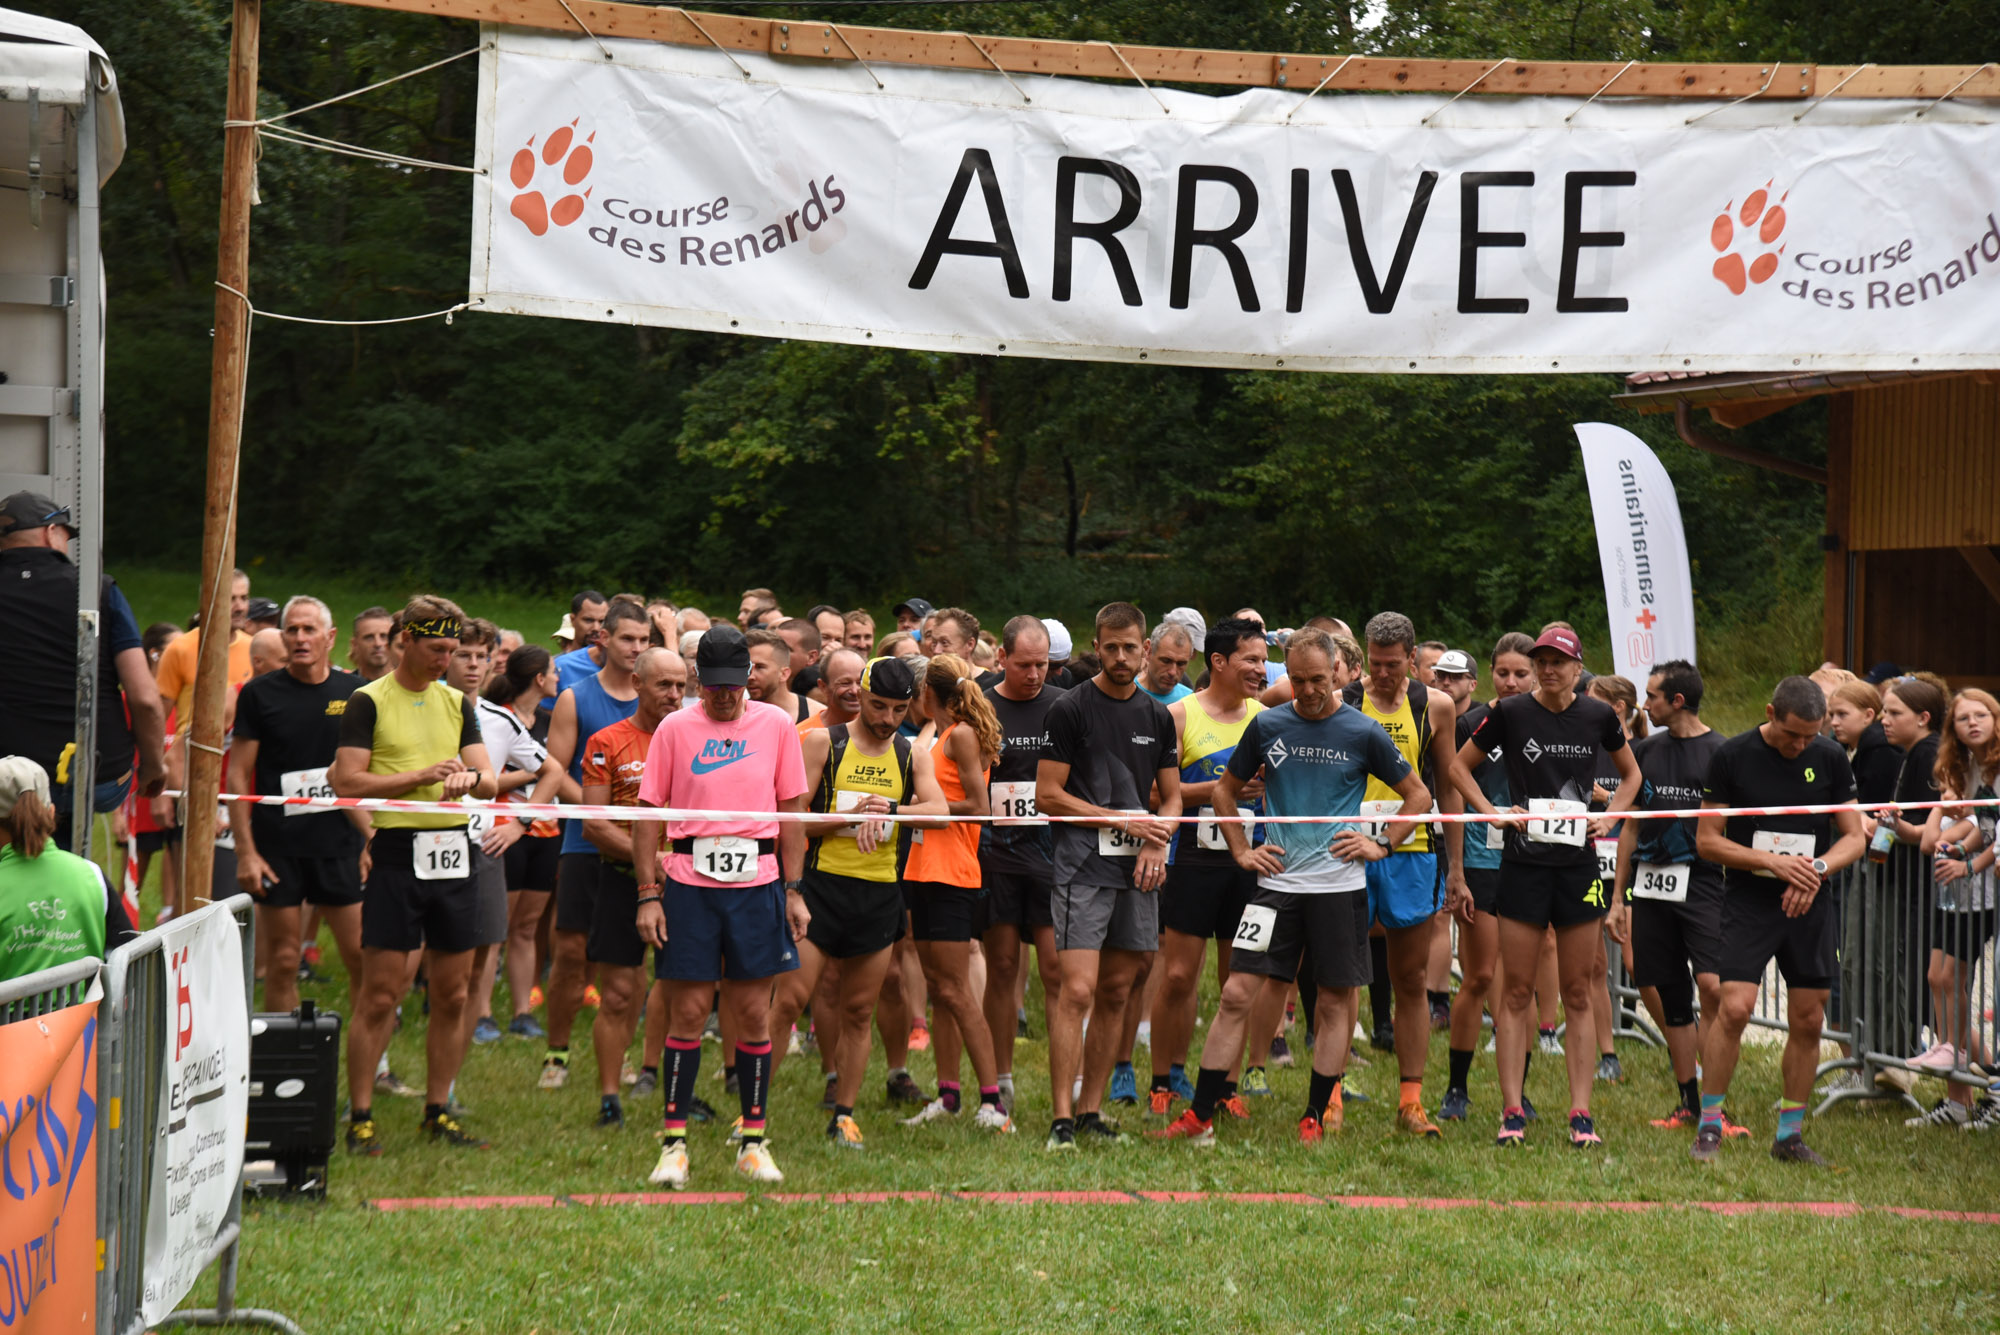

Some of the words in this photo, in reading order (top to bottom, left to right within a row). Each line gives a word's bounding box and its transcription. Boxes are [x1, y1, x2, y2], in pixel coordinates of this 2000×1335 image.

[588, 226, 666, 264] des
[679, 174, 846, 267] Renards
[602, 196, 729, 228] Course
[908, 147, 1637, 315] ARRIVEE
[1794, 238, 1913, 275] Course
[1781, 279, 1855, 310] des
[701, 739, 747, 758] RUN
[1290, 746, 1349, 761] VERTICAL
[1543, 744, 1593, 754] VERTICAL
[855, 765, 887, 777] USY
[1655, 785, 1703, 798] VERTICAL
[1003, 798, 1038, 817] 183
[427, 849, 462, 871] 162
[705, 852, 747, 873] 137
[1644, 872, 1678, 893] 349
[1237, 921, 1262, 943] 22
